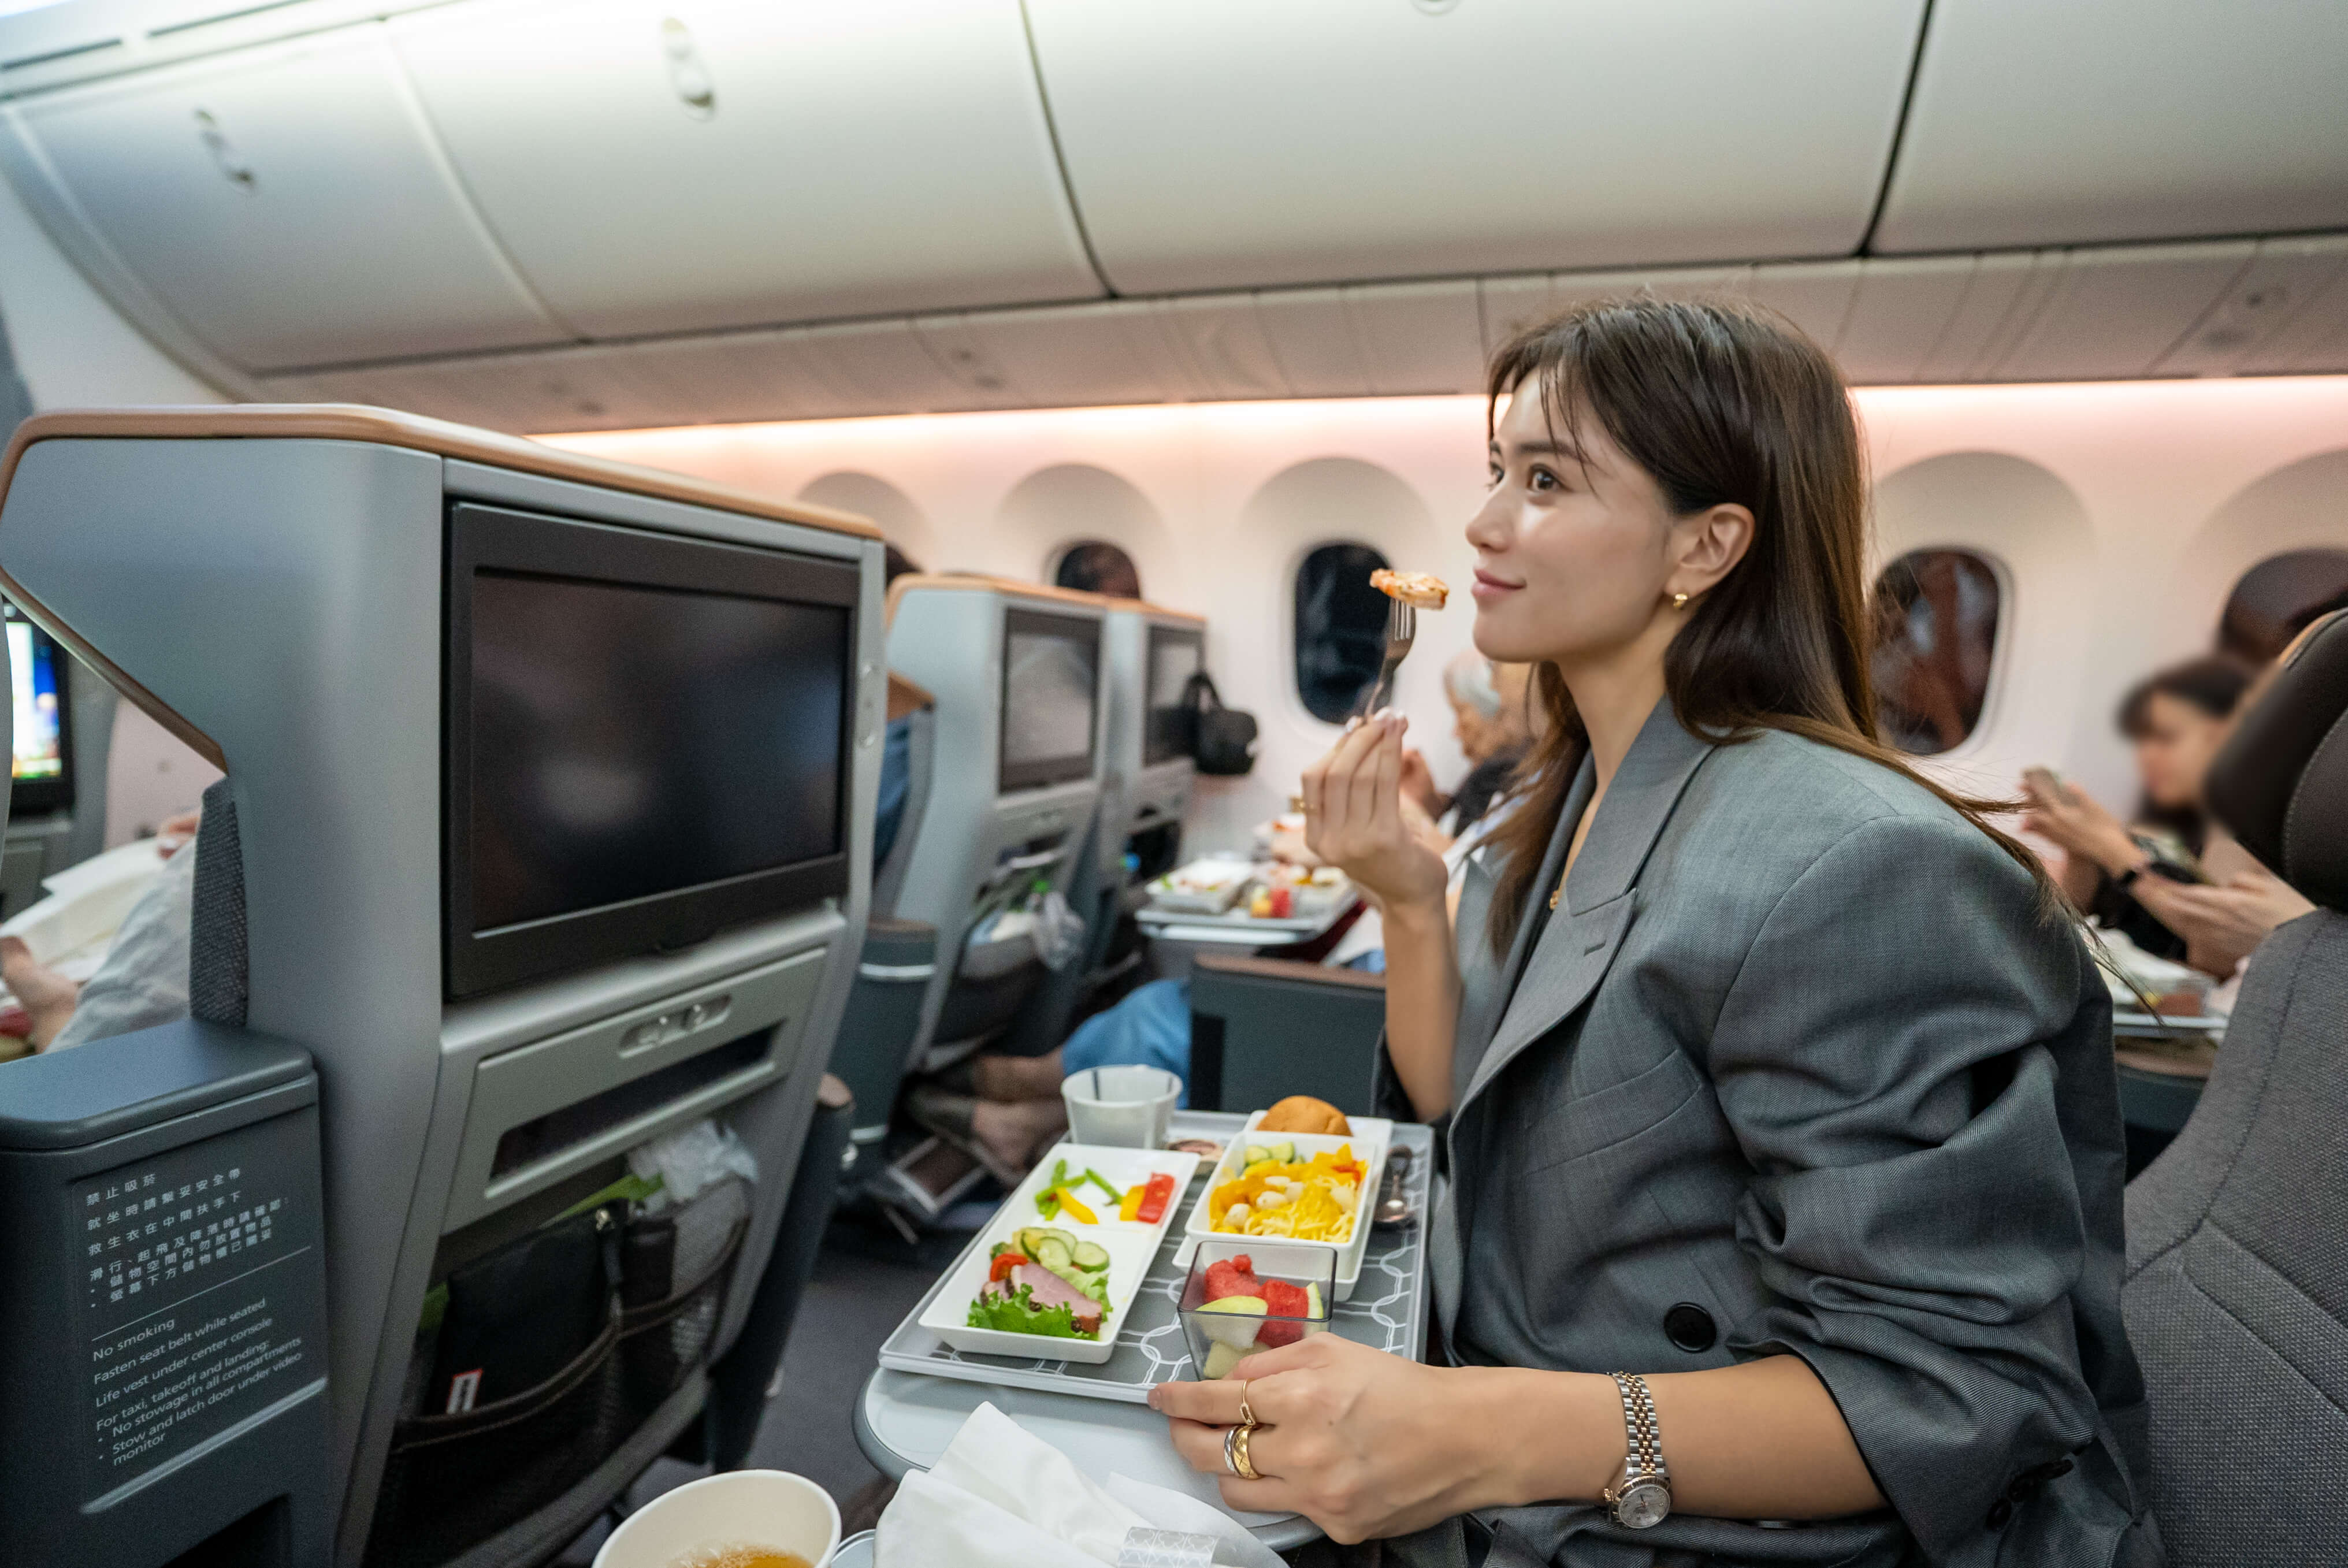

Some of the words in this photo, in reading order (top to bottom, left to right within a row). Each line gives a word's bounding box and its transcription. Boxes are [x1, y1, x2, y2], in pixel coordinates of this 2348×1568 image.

[92, 1347, 113, 1362] No
[117, 1319, 175, 1350] smoking
[94, 1361, 136, 1384] Fasten
[140, 1344, 166, 1362] seat
[169, 1333, 193, 1351] belt
[195, 1317, 226, 1337] while
[229, 1298, 265, 1320] seated
[95, 1389, 120, 1407] Life
[123, 1376, 148, 1392] vest
[153, 1358, 188, 1380] under
[191, 1339, 227, 1361] center
[231, 1318, 272, 1342] console
[96, 1414, 116, 1431] For
[122, 1398, 147, 1417] taxi,
[151, 1372, 197, 1403] takeoff
[199, 1361, 221, 1380] and
[113, 1420, 132, 1437] No
[135, 1394, 189, 1424] stowage
[192, 1387, 203, 1396] in
[206, 1377, 220, 1389] all
[222, 1338, 301, 1381] compartments
[113, 1431, 146, 1454] Stow
[149, 1415, 173, 1435] and
[176, 1400, 205, 1421] latch
[207, 1387, 236, 1405] door
[238, 1370, 269, 1389] under
[273, 1353, 302, 1372] video
[113, 1433, 165, 1466] monitor
